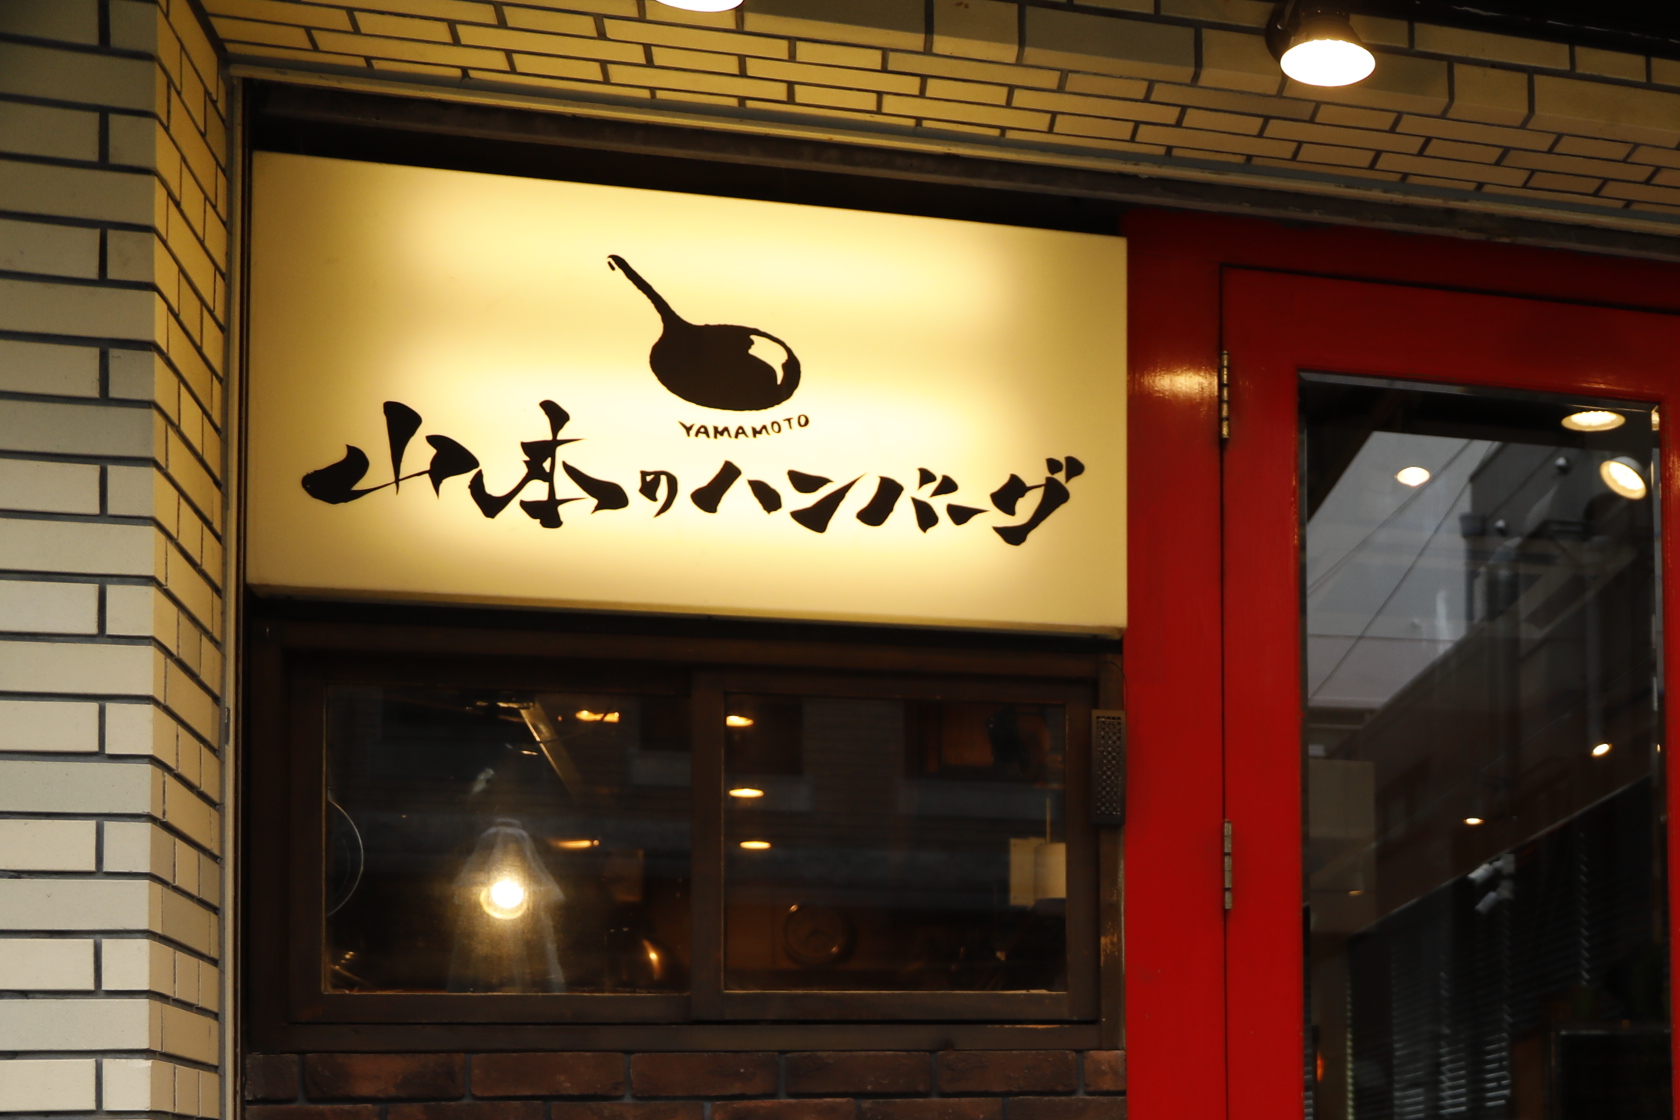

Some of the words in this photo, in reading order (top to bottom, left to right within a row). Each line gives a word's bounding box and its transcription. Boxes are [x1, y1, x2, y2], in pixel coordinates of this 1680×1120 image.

[678, 413, 811, 440] YAMAMOTO
[301, 399, 1086, 547] 山本のハンバーグ
